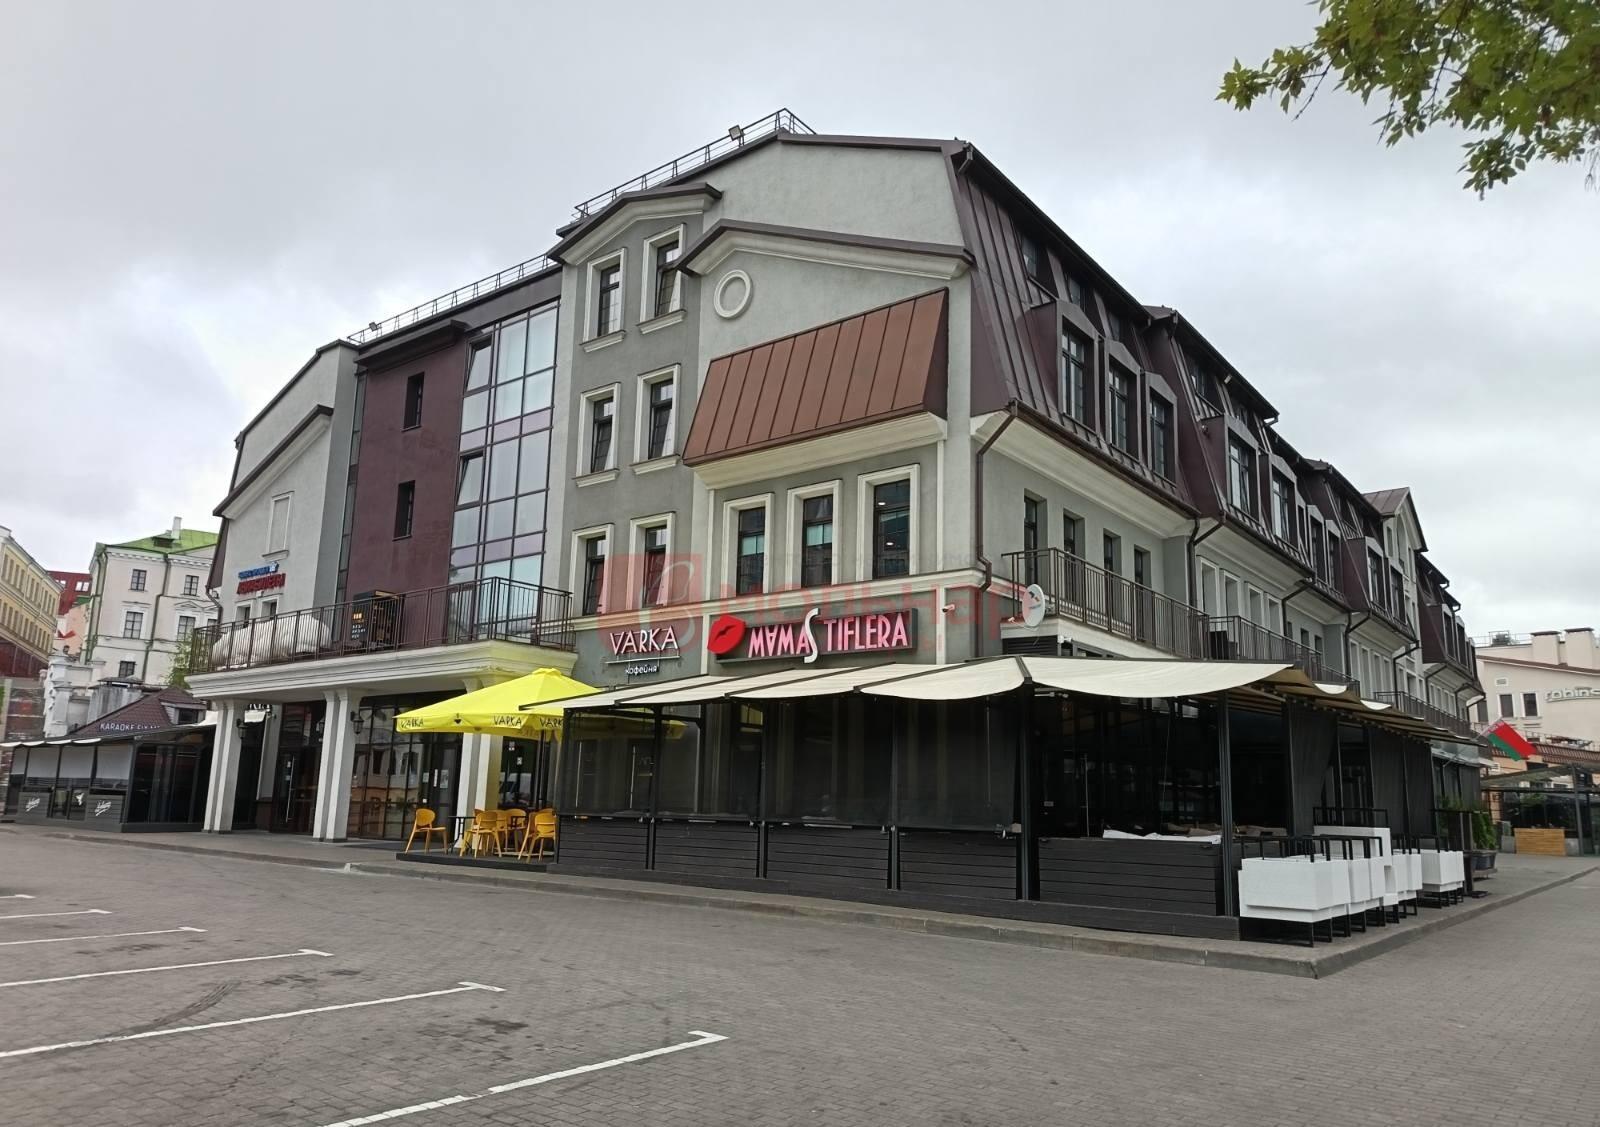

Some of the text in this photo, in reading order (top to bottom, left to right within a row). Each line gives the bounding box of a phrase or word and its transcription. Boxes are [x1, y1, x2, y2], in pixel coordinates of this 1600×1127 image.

[609, 625, 680, 656] VARKA
[803, 608, 909, 664] STIFLERA
[625, 664, 659, 676] кофейня
